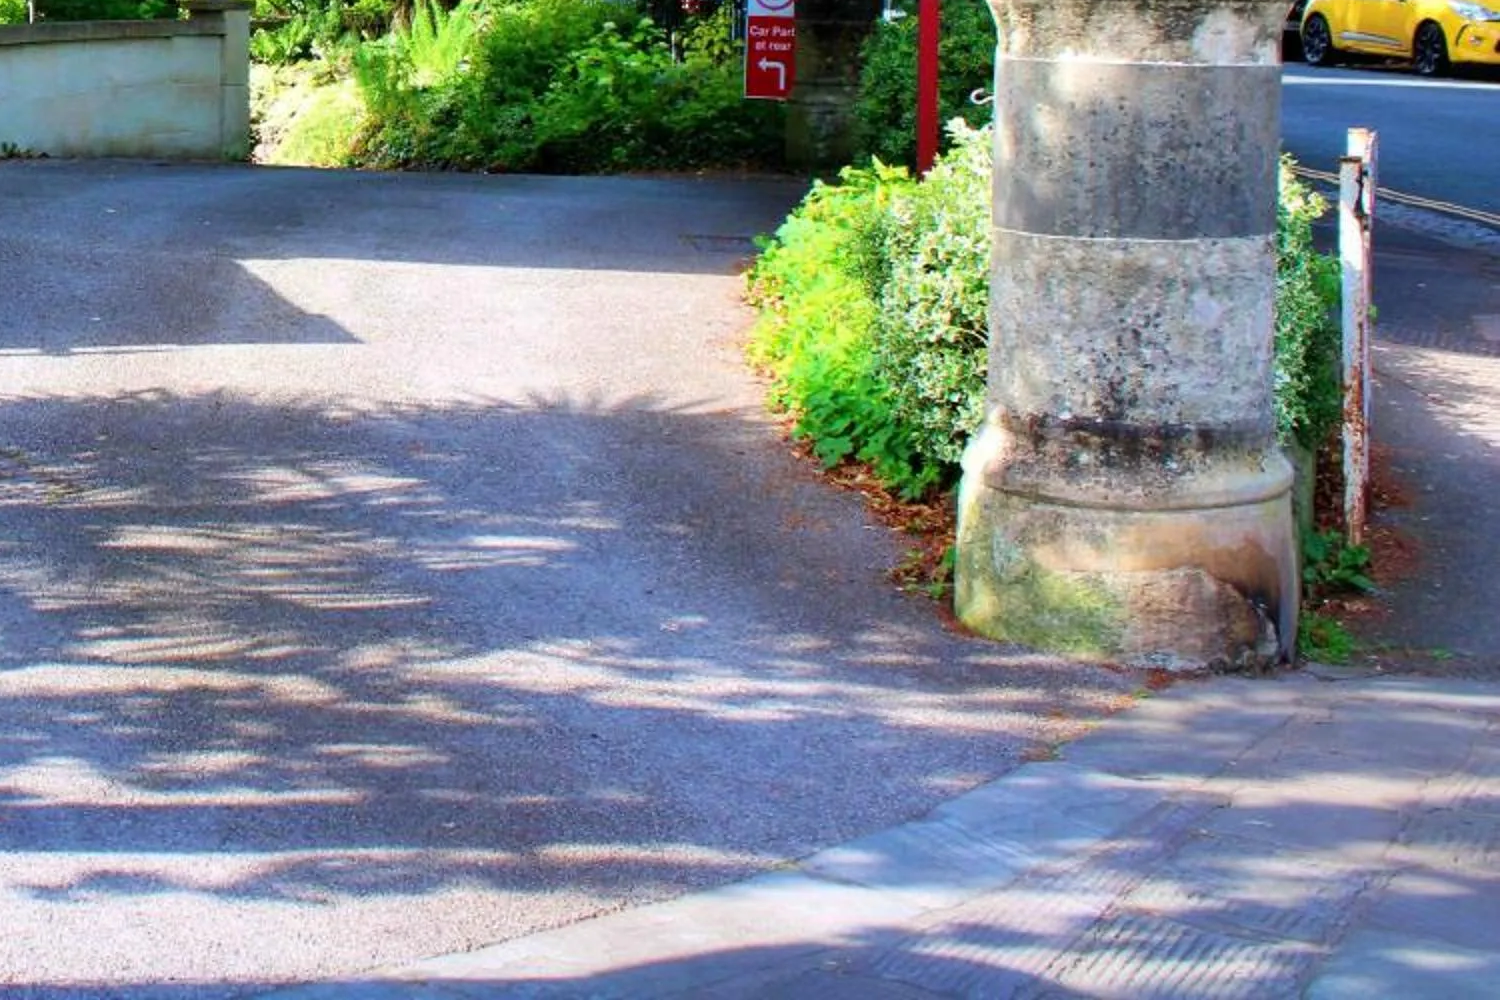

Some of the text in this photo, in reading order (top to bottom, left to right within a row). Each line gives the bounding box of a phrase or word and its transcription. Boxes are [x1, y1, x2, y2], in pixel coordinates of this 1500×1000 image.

[750, 25, 769, 37] Car
[755, 40, 792, 51] at rear
